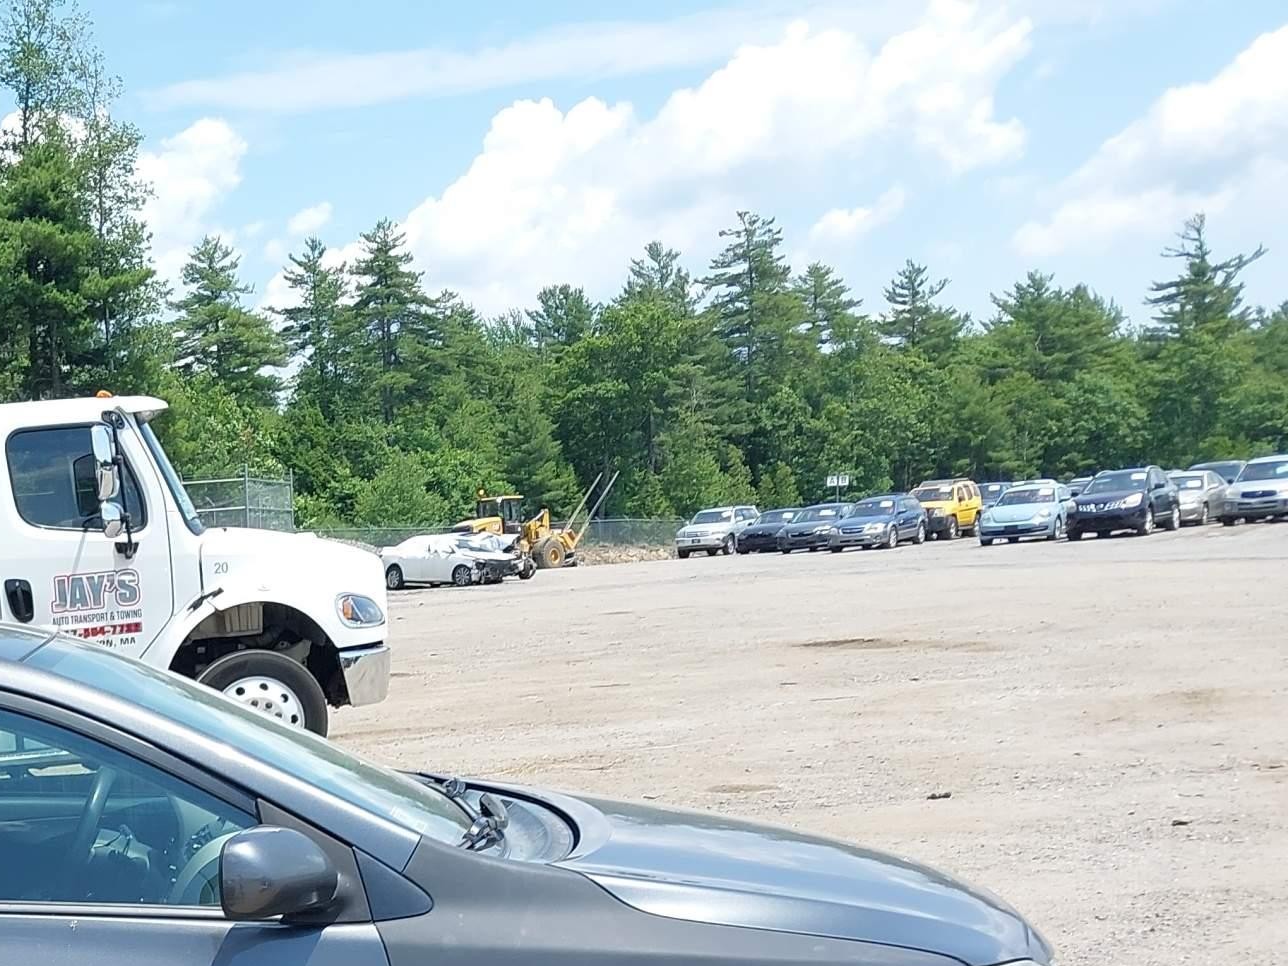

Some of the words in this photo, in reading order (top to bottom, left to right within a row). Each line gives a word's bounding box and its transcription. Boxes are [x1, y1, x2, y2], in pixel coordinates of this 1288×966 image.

[214, 561, 228, 574] 20
[52, 569, 140, 613] JAY'S
[52, 616, 70, 625] AUTO
[71, 612, 108, 624] TRANSPORT
[110, 612, 115, 621] &
[116, 609, 142, 620] TOWING
[120, 637, 136, 645] MA
